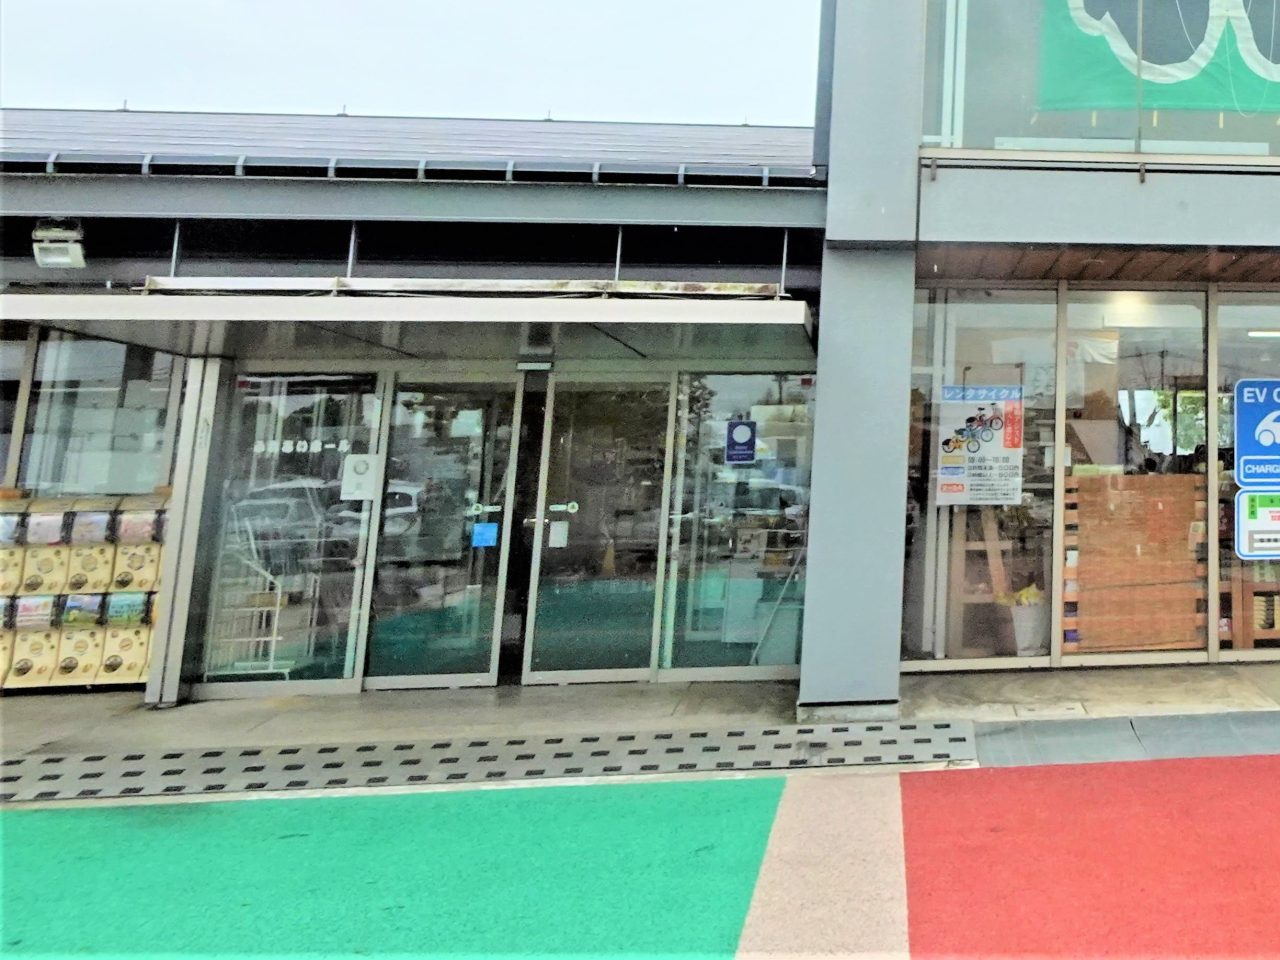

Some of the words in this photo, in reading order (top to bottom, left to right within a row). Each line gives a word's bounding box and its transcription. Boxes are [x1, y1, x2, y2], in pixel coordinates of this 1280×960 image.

[944, 388, 1021, 400] レンタサイクル
[1243, 387, 1267, 403] EV
